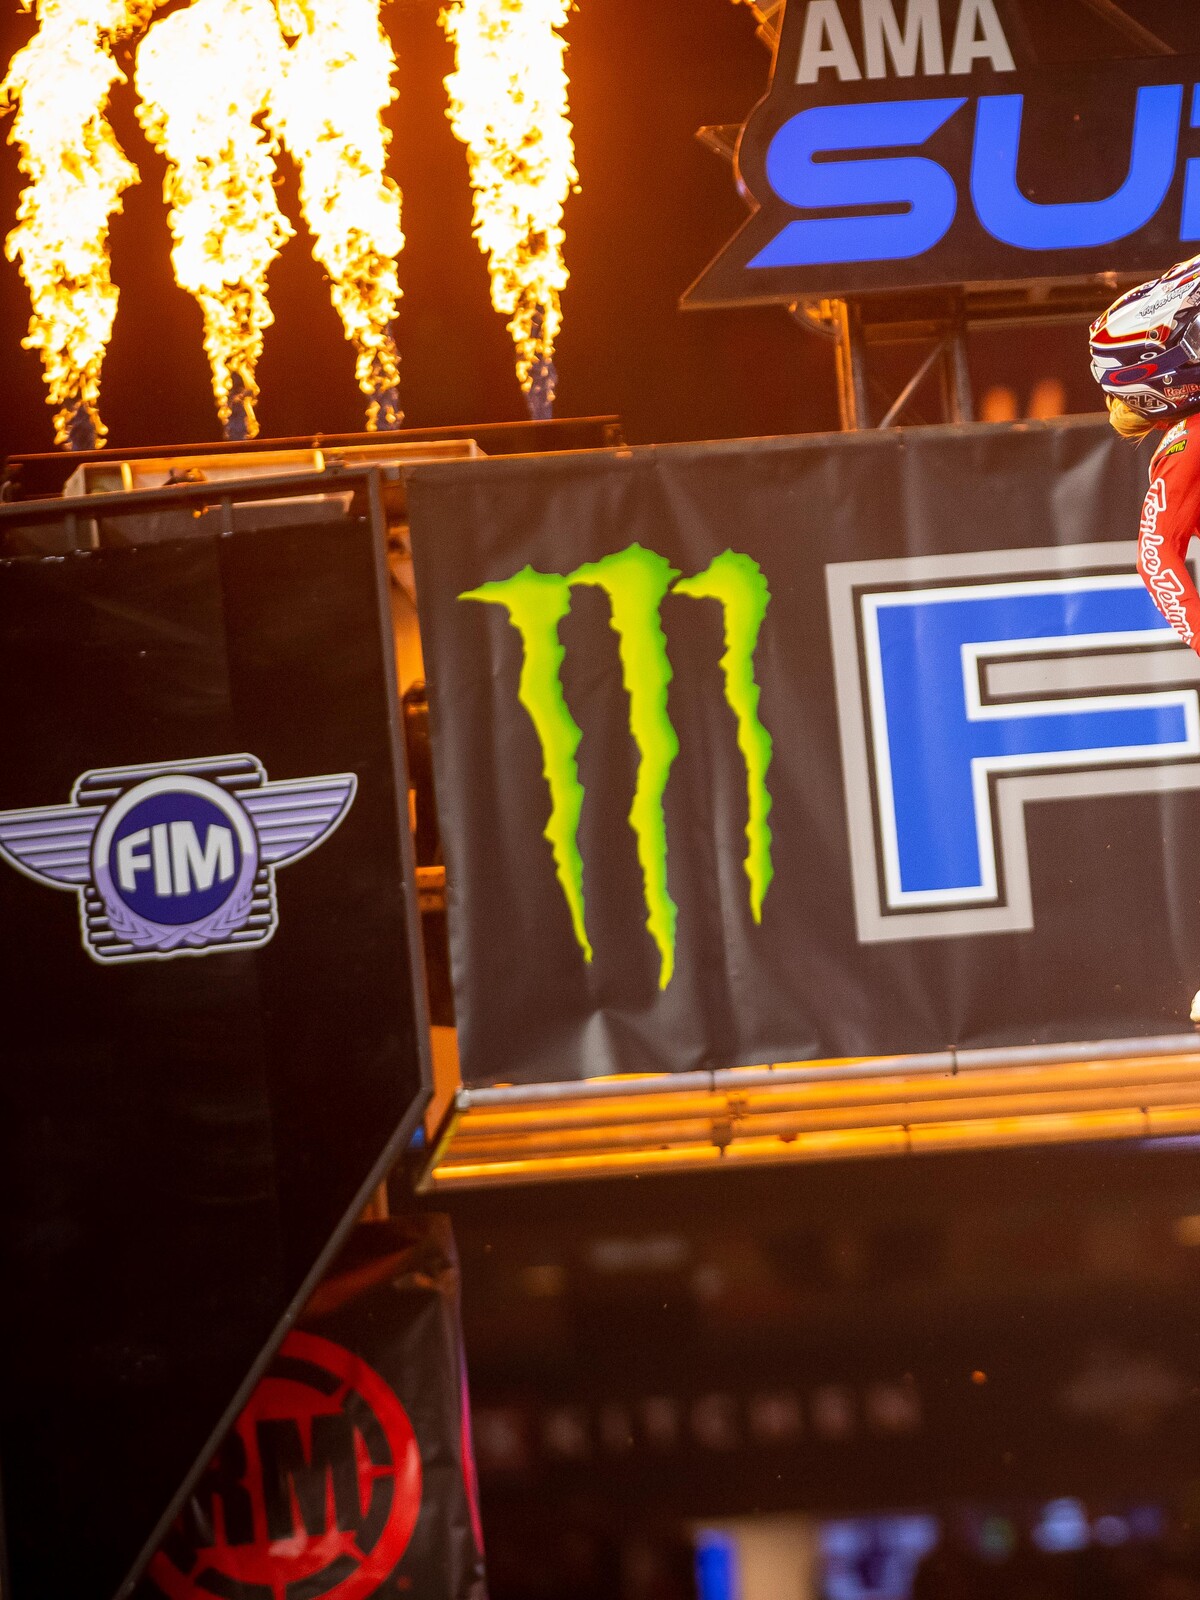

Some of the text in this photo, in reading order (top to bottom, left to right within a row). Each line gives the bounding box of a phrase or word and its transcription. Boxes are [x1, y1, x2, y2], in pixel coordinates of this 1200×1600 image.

[795, 0, 1016, 84] AMA
[1163, 384, 1188, 398] Red
[1140, 477, 1167, 534] Troy
[1141, 533, 1164, 576] Lee
[117, 820, 235, 897] FIM
